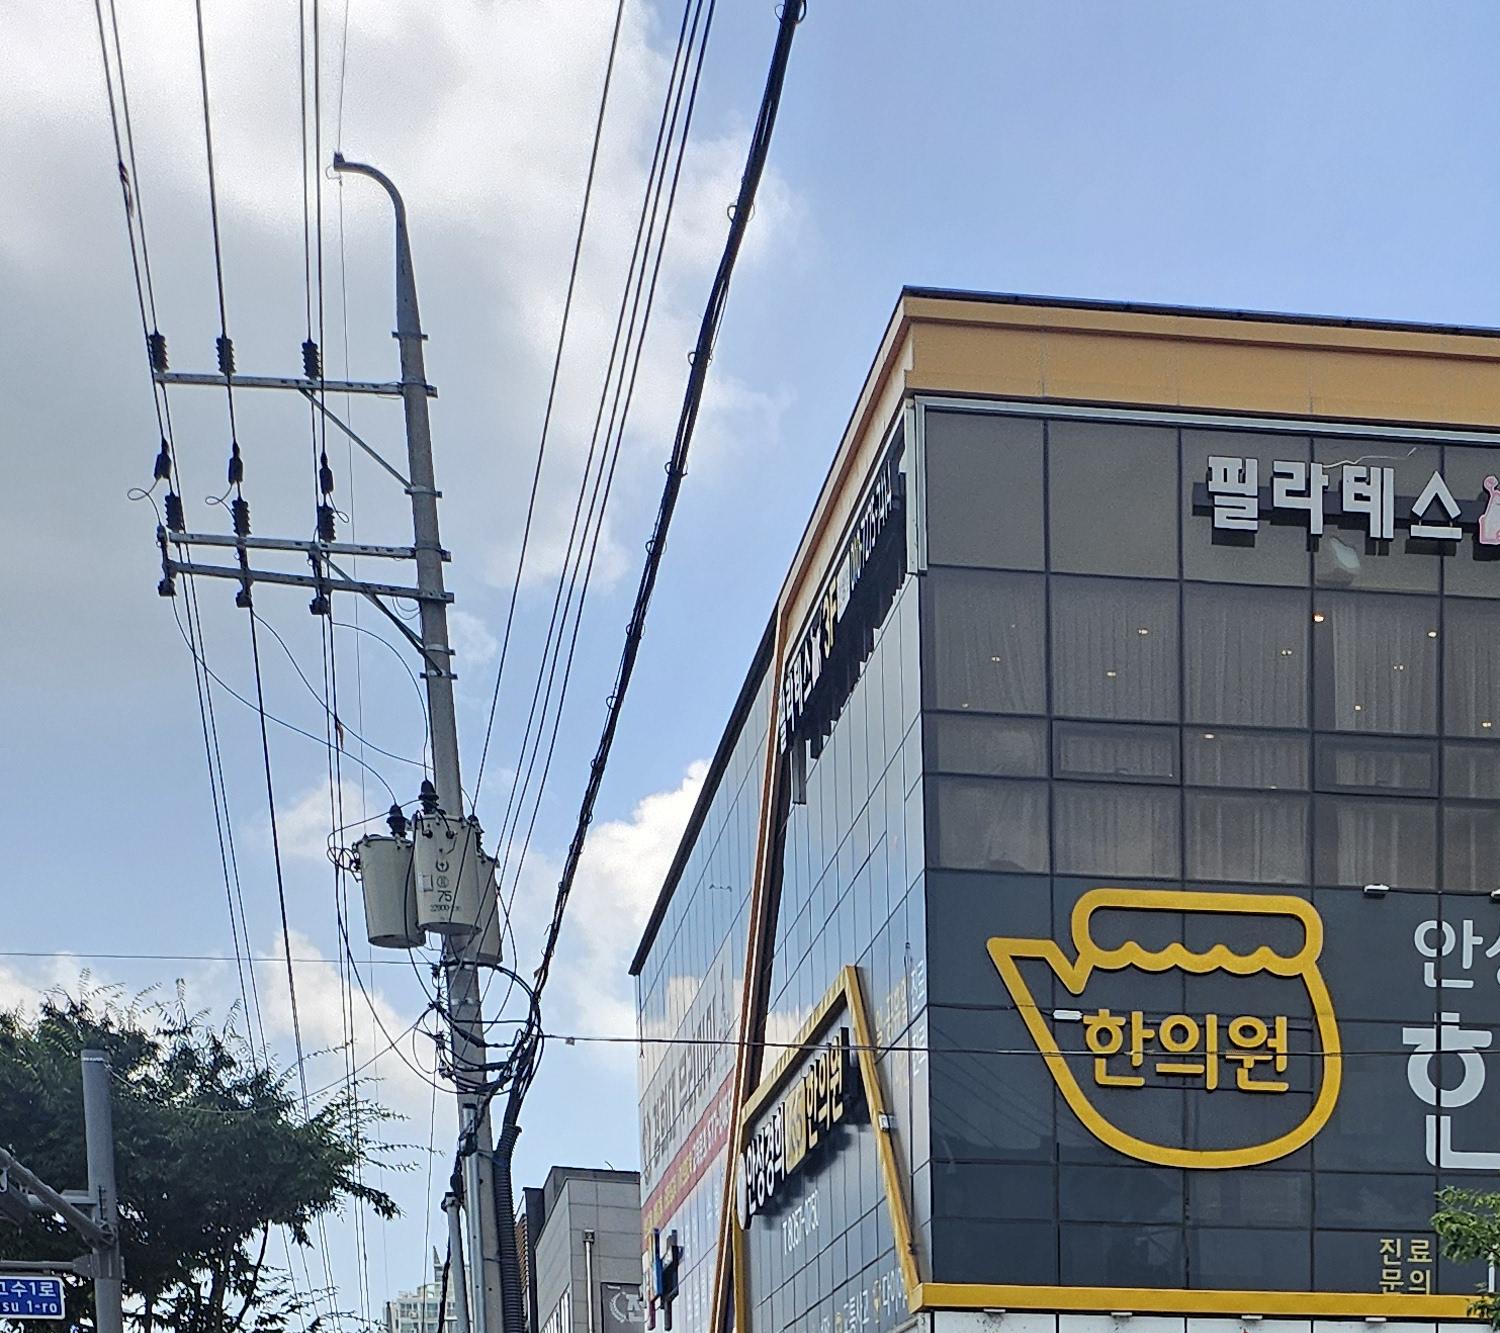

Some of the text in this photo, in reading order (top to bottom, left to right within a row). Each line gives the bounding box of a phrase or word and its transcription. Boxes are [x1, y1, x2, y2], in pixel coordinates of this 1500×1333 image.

[1207, 455, 1464, 541] 필라테스
[437, 890, 452, 902] 75
[1082, 1008, 1288, 1092] 한의원
[1379, 1238, 1433, 1265] 진료
[1379, 1268, 1431, 1295] 문의
[26, 1300, 58, 1313] 1-ro
